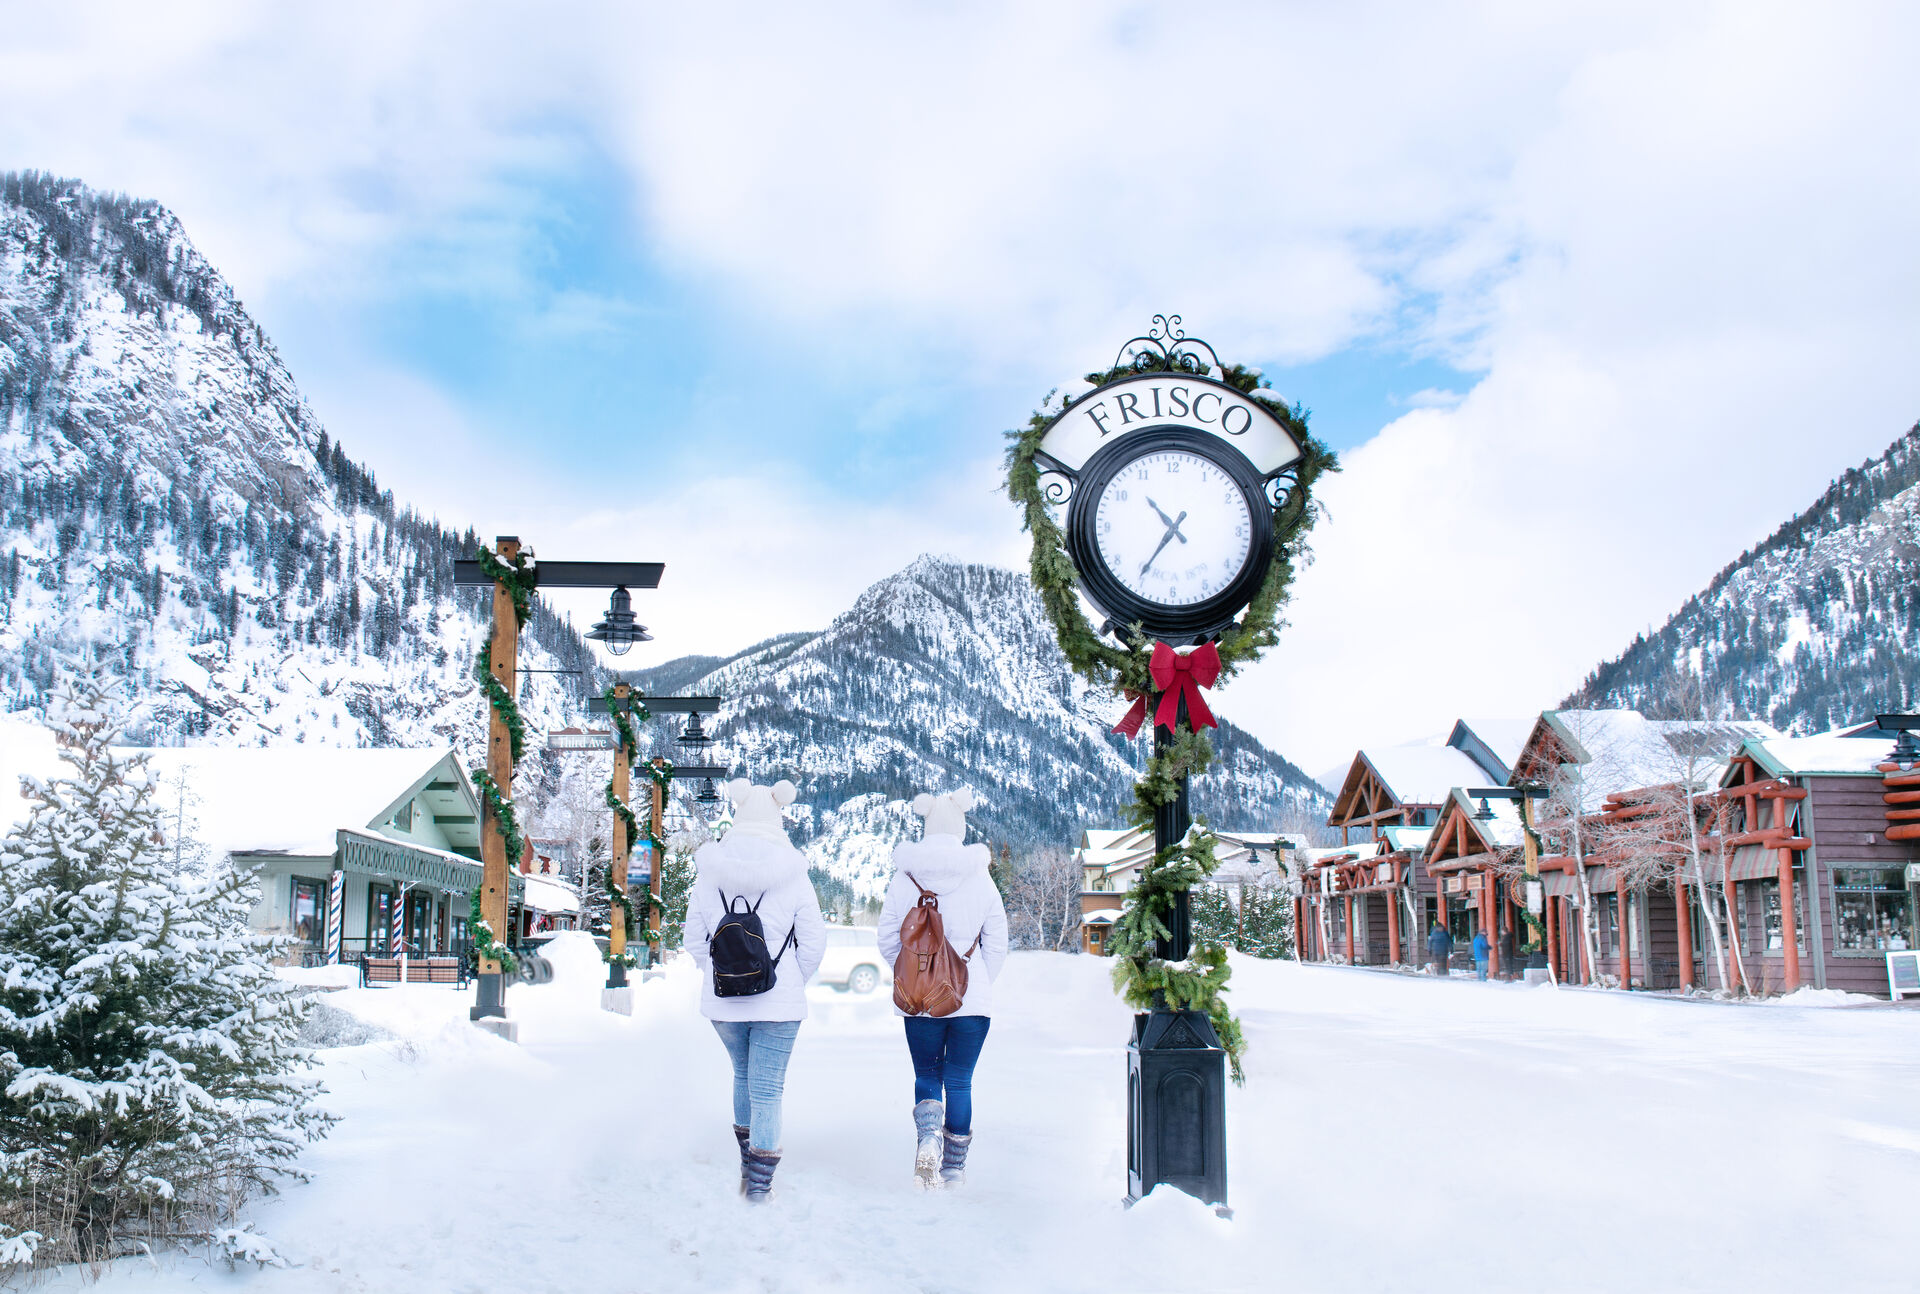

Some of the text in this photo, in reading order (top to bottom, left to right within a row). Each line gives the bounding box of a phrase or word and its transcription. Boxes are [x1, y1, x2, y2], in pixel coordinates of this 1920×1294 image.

[1084, 386, 1252, 438] FRISCO
[1166, 462, 1179, 473] 12
[1137, 469, 1149, 481] 11
[1201, 472, 1207, 482] 1
[1115, 490, 1128, 502] 10
[1224, 494, 1232, 505] 2
[1104, 522, 1111, 533] 9
[1235, 526, 1242, 537] 3
[1114, 554, 1121, 565] 8
[1223, 558, 1230, 569] 4
[1138, 561, 1179, 582] CRCA
[1139, 575, 1146, 588] 7
[1202, 579, 1208, 591] 5
[1169, 586, 1177, 598] 6
[559, 736, 607, 748] Third Ave
